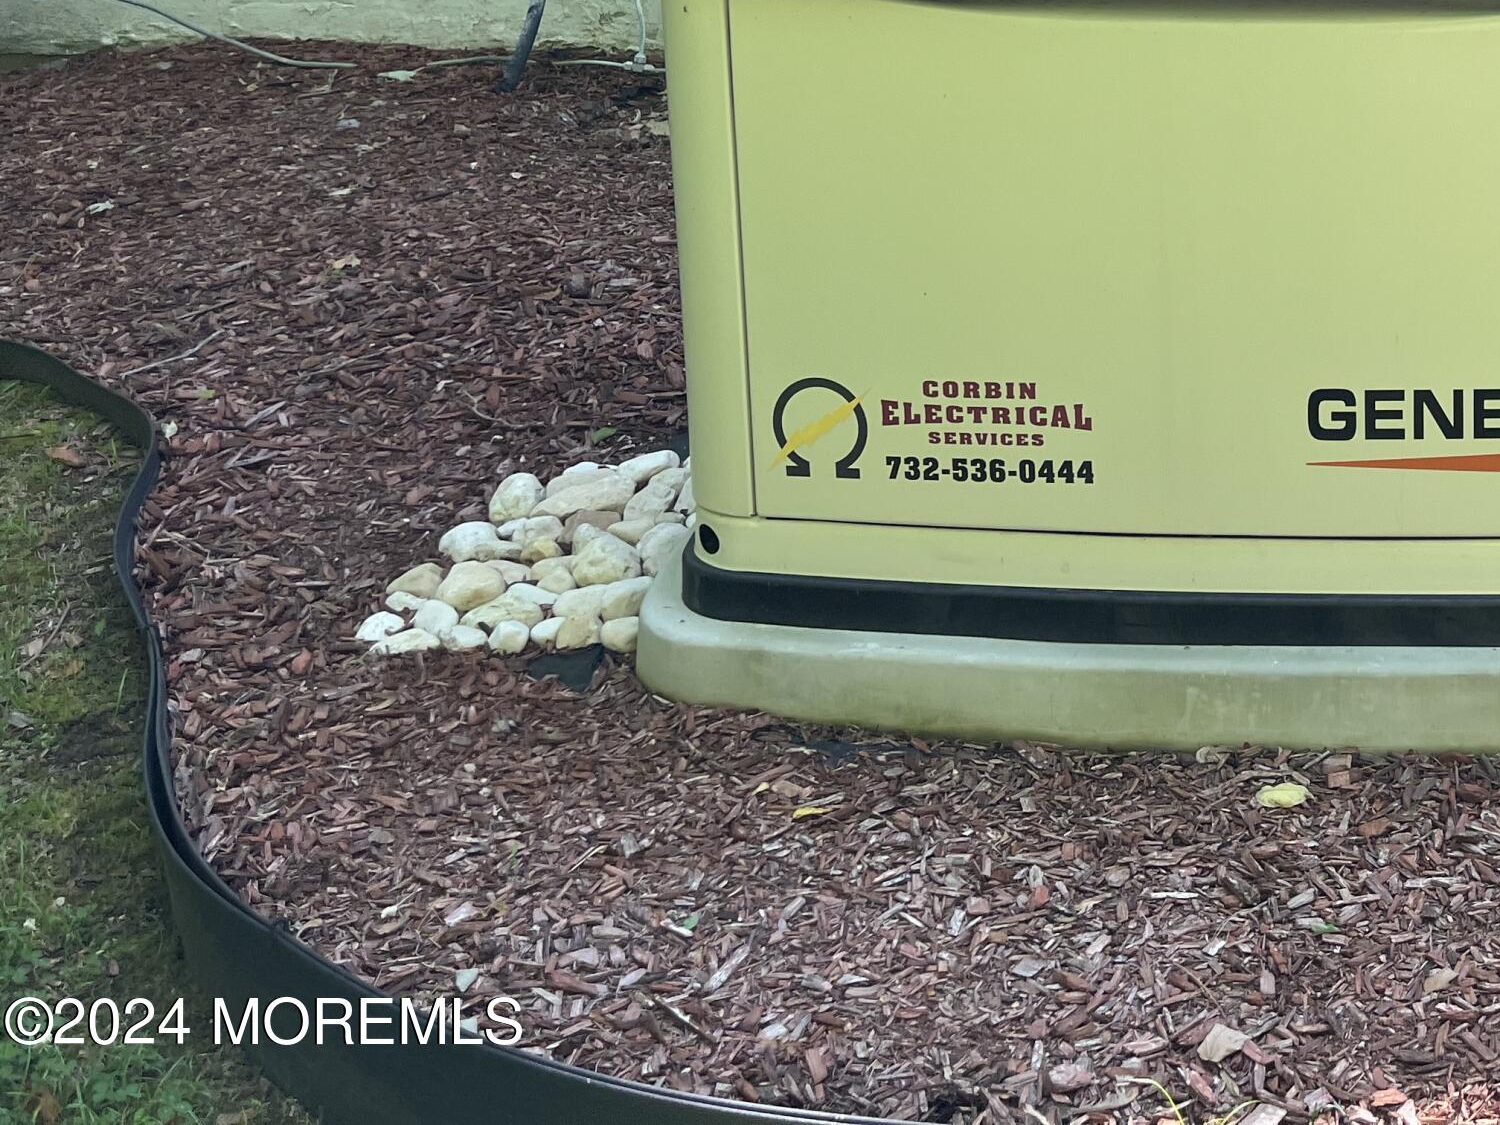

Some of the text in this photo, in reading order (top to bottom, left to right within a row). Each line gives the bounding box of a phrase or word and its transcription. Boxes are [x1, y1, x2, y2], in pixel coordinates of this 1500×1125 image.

[922, 380, 1037, 400] CORBIN
[880, 399, 1094, 431] ELECTRICAL
[928, 431, 1045, 447] SERVICES
[885, 455, 1095, 484] 732-536-0444
